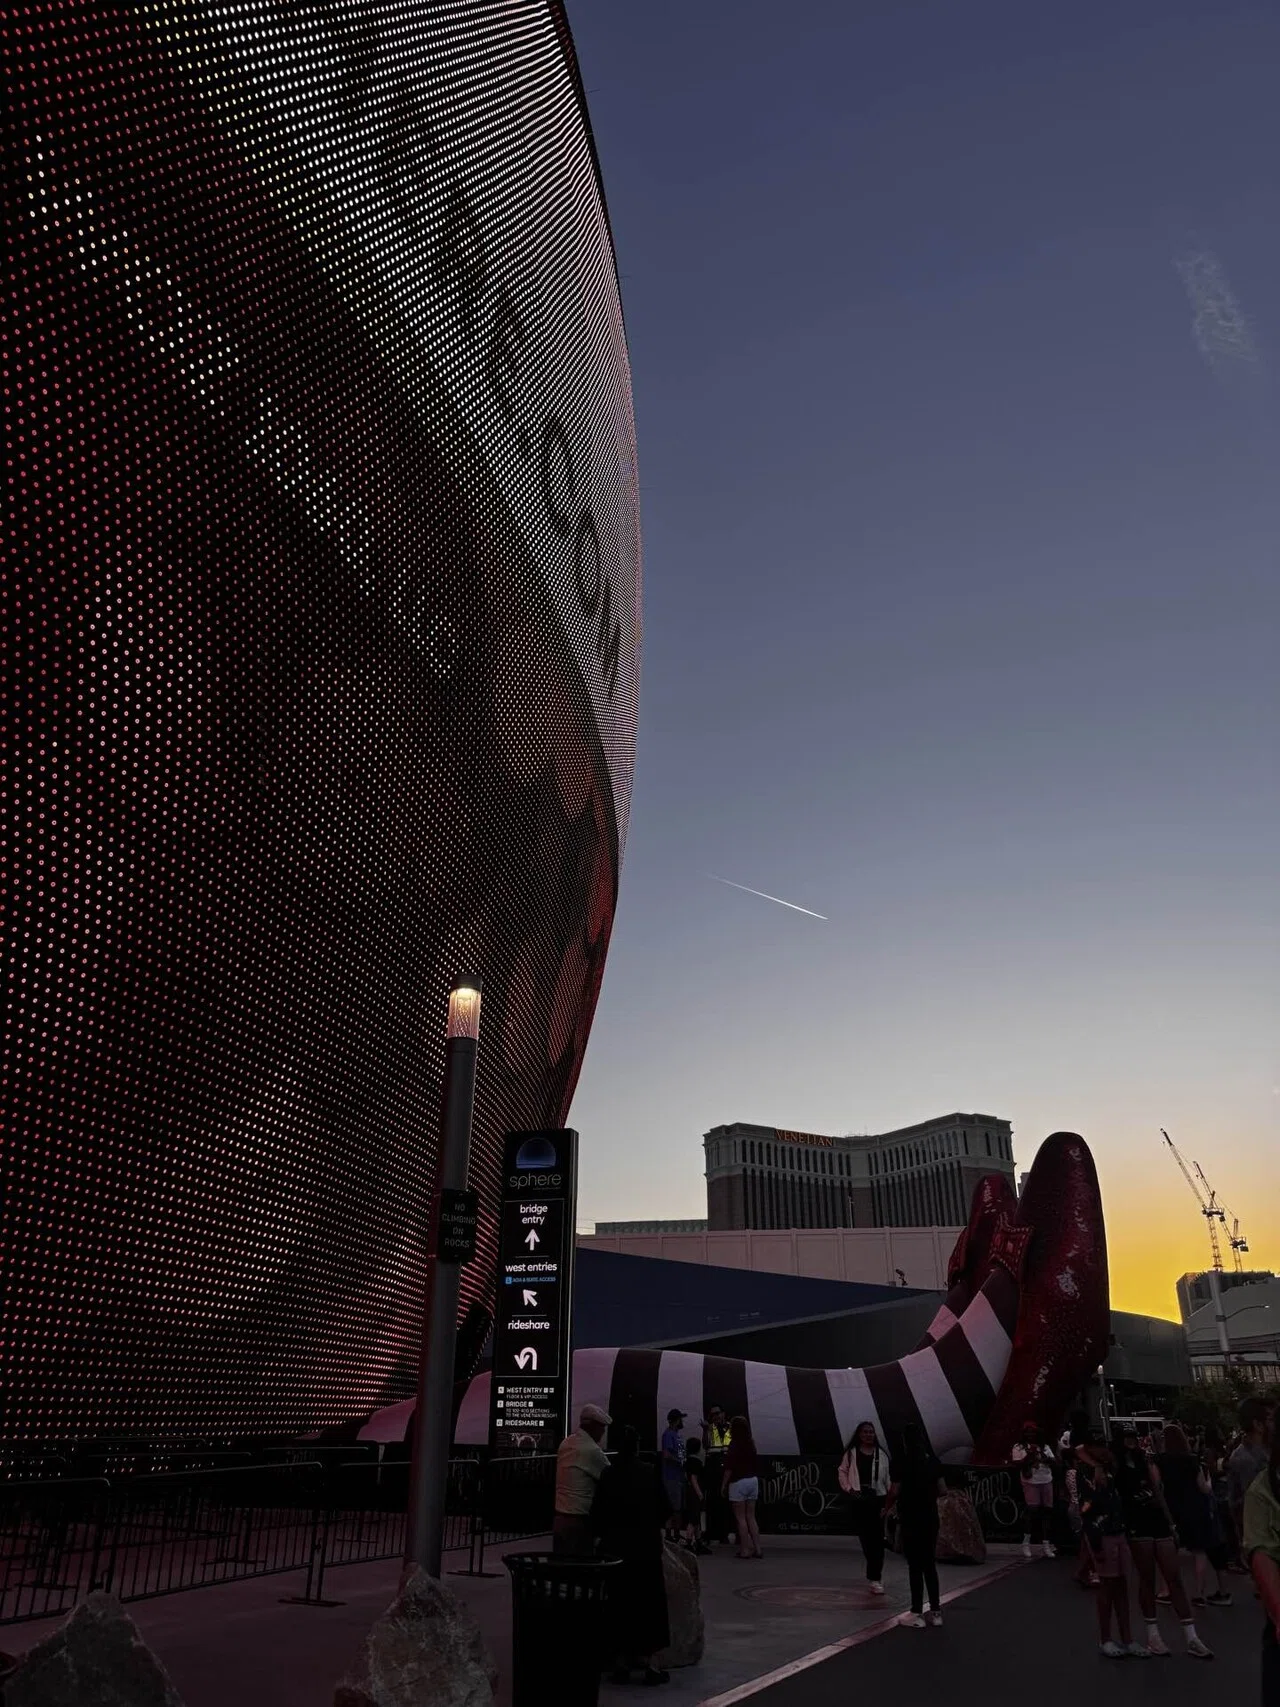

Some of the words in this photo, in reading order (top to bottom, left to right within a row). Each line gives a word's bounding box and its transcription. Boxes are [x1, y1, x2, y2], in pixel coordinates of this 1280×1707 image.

[775, 1129, 833, 1147] VENETIAN
[509, 1171, 562, 1190] sphere
[454, 1203, 466, 1212] NO
[520, 1204, 548, 1215] bridge
[441, 1213, 476, 1225] CLIMBING
[521, 1216, 545, 1226] entry
[452, 1226, 464, 1236] ON
[444, 1238, 470, 1249] ROCKS
[505, 1263, 526, 1272] west
[527, 1262, 558, 1272] entries
[508, 1320, 550, 1330] rideshare
[760, 1461, 820, 1505] WIZARD
